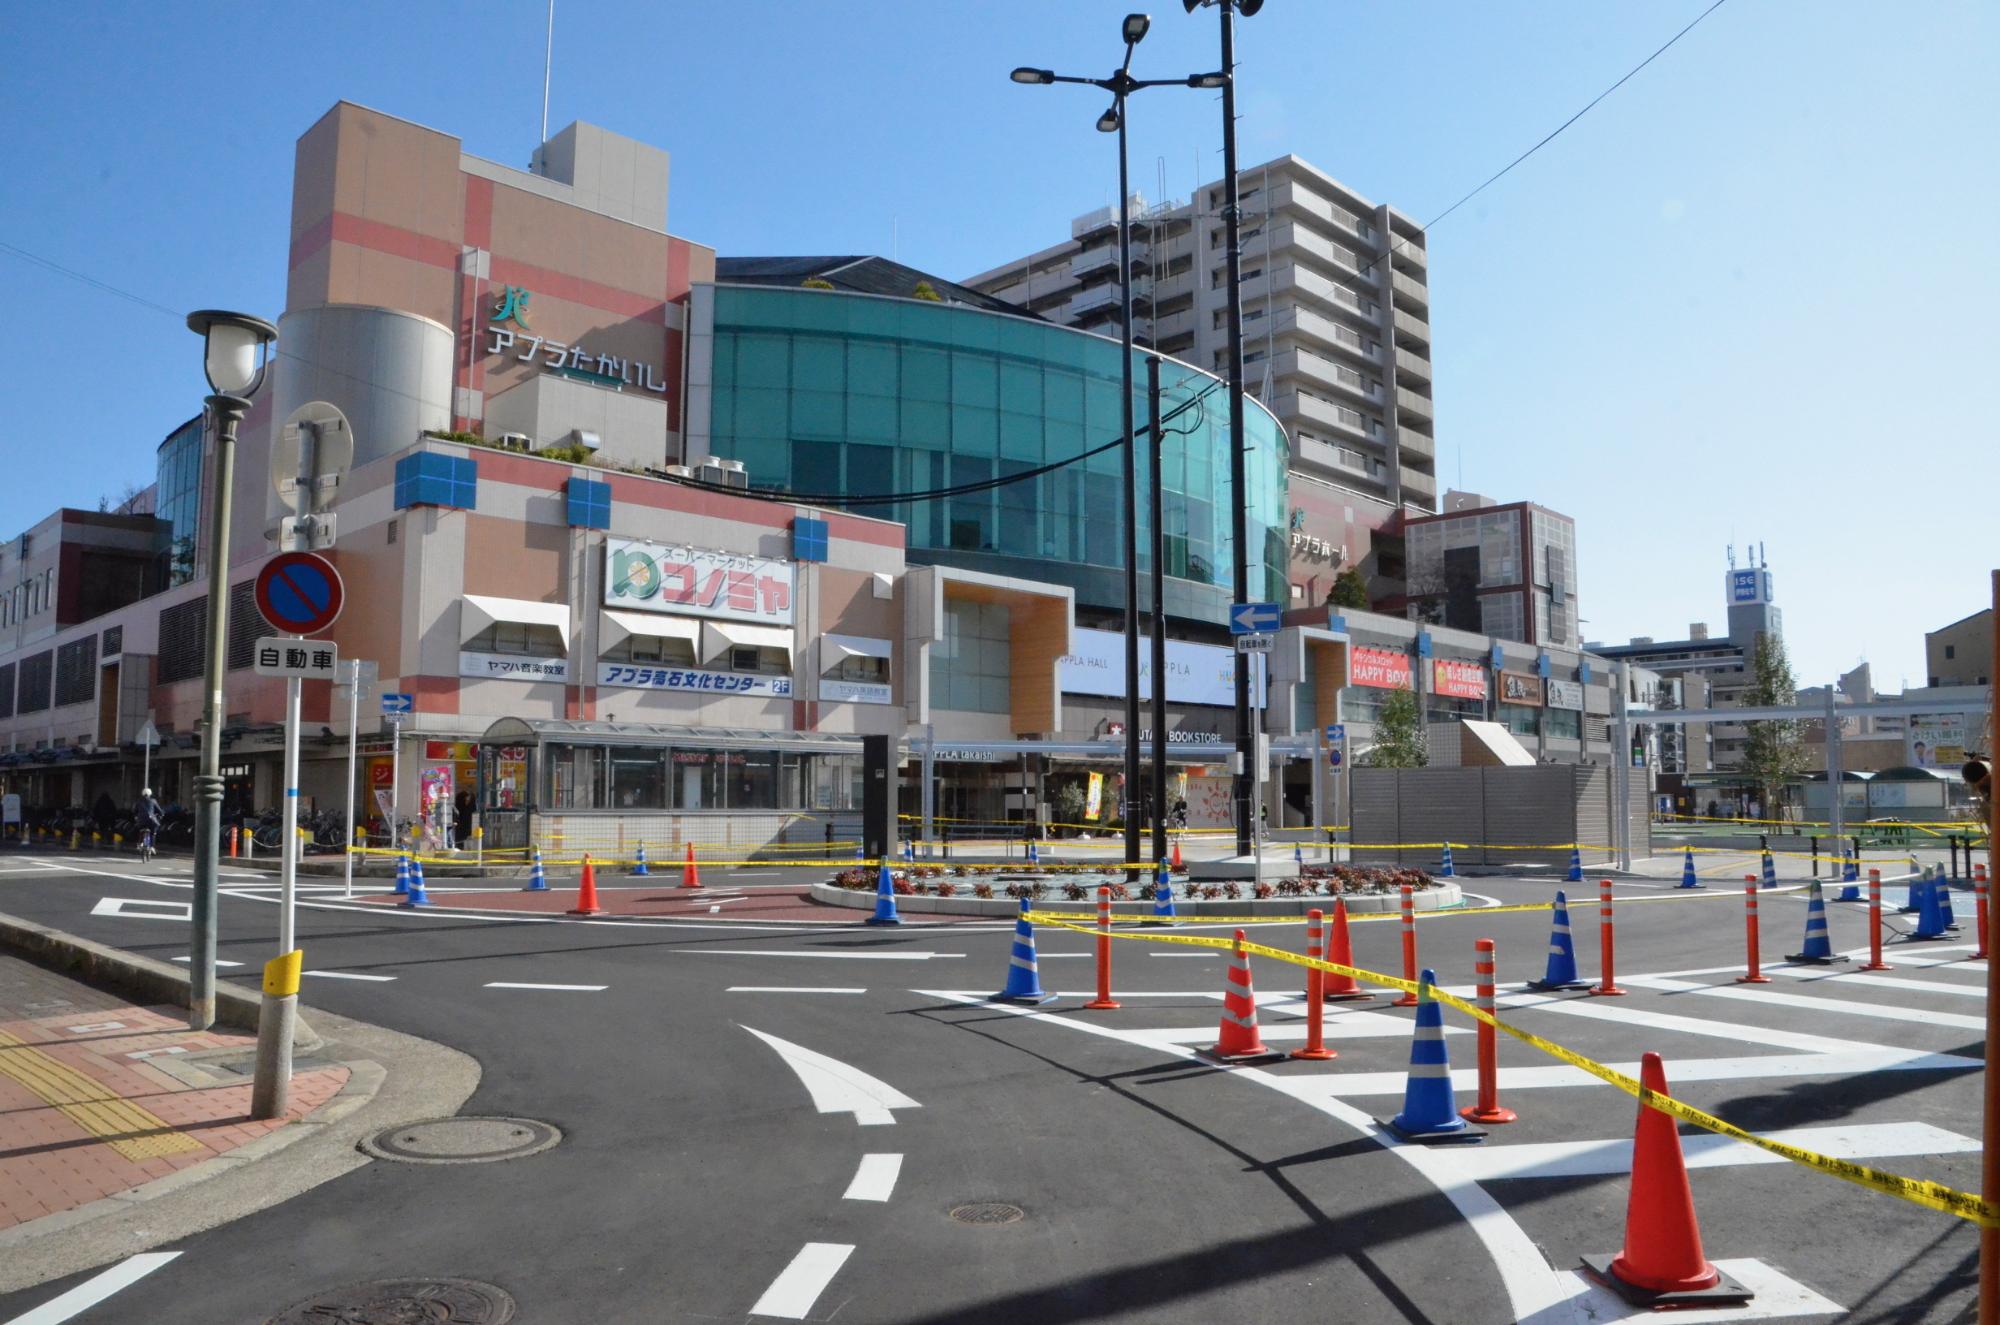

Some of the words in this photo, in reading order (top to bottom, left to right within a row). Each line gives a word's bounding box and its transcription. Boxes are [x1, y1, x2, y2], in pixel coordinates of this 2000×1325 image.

[487, 326, 667, 392] アプラたかいし
[1291, 532, 1348, 561] アプラホール
[663, 548, 755, 571] スーパーマーケット
[662, 562, 790, 614] コノミヤ
[260, 647, 333, 670] 自動車
[488, 661, 565, 676] ヤマハ音楽教室
[1087, 658, 1108, 669] HALL
[605, 667, 766, 691] アプラ高石文化センター
[773, 681, 789, 693] 2F
[1353, 664, 1384, 680] HAPPY
[1386, 670, 1408, 686] BOX
[1448, 683, 1468, 695] HAPPY
[1168, 731, 1222, 744] BOOKSTORE
